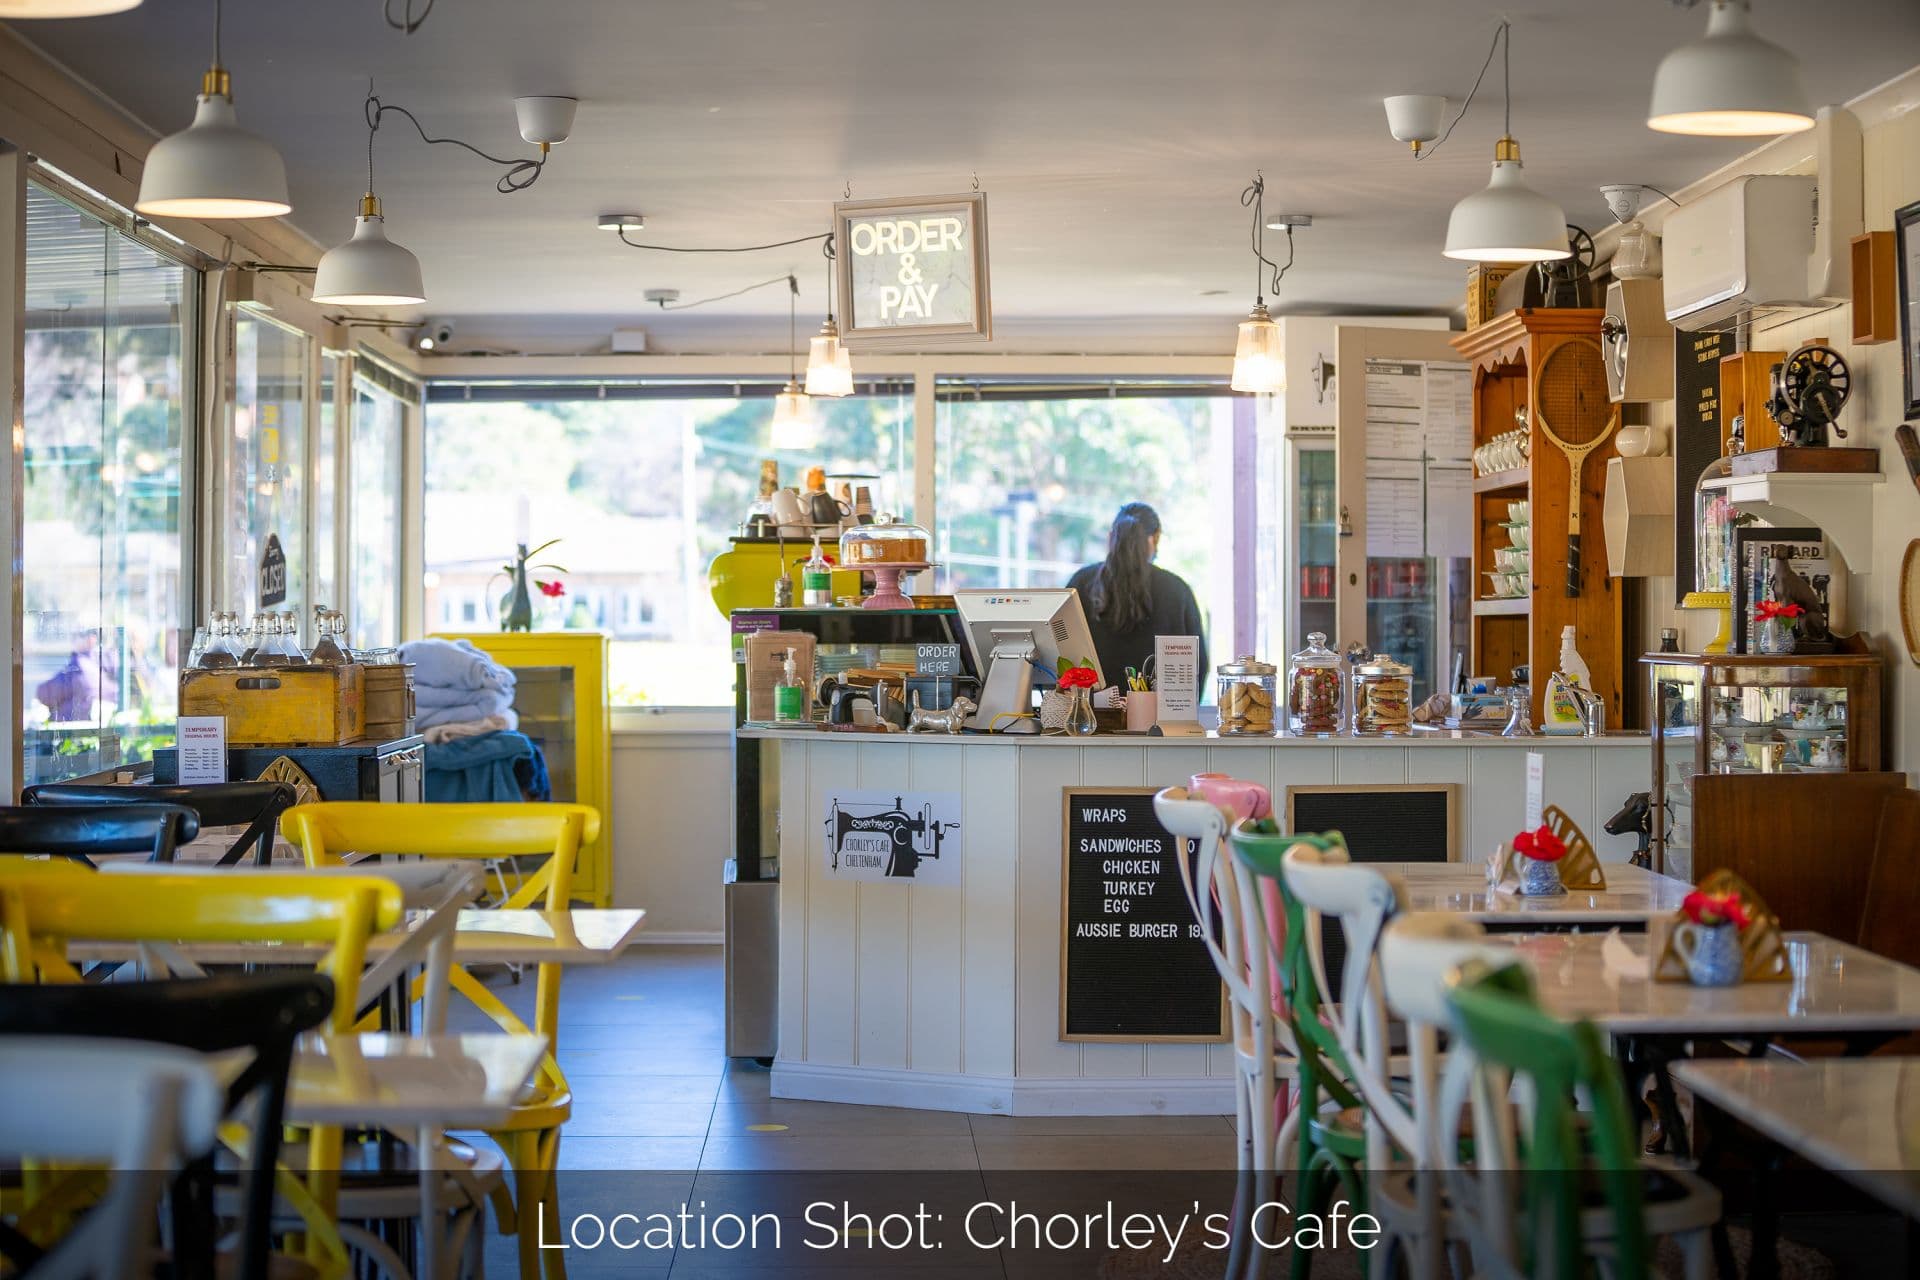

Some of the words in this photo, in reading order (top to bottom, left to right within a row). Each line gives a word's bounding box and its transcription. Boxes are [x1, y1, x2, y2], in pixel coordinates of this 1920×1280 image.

[851, 217, 963, 256] ORDER
[898, 252, 923, 286] &
[879, 284, 939, 319] PAY
[918, 646, 957, 658] ORDER
[920, 661, 950, 673] HERE
[1082, 808, 1127, 823] WRAPS
[845, 838, 875, 852] CHORLEY'S
[875, 839, 890, 853] CAFE
[1080, 837, 1162, 853] SANDWICHES
[845, 854, 882, 868] CHELTENHAM
[1102, 859, 1161, 876] CHICKEN
[1103, 881, 1156, 896] TURKEY
[1103, 899, 1130, 914] EGG
[1076, 923, 1122, 938] AUSSIE
[1129, 923, 1178, 939] BURGER
